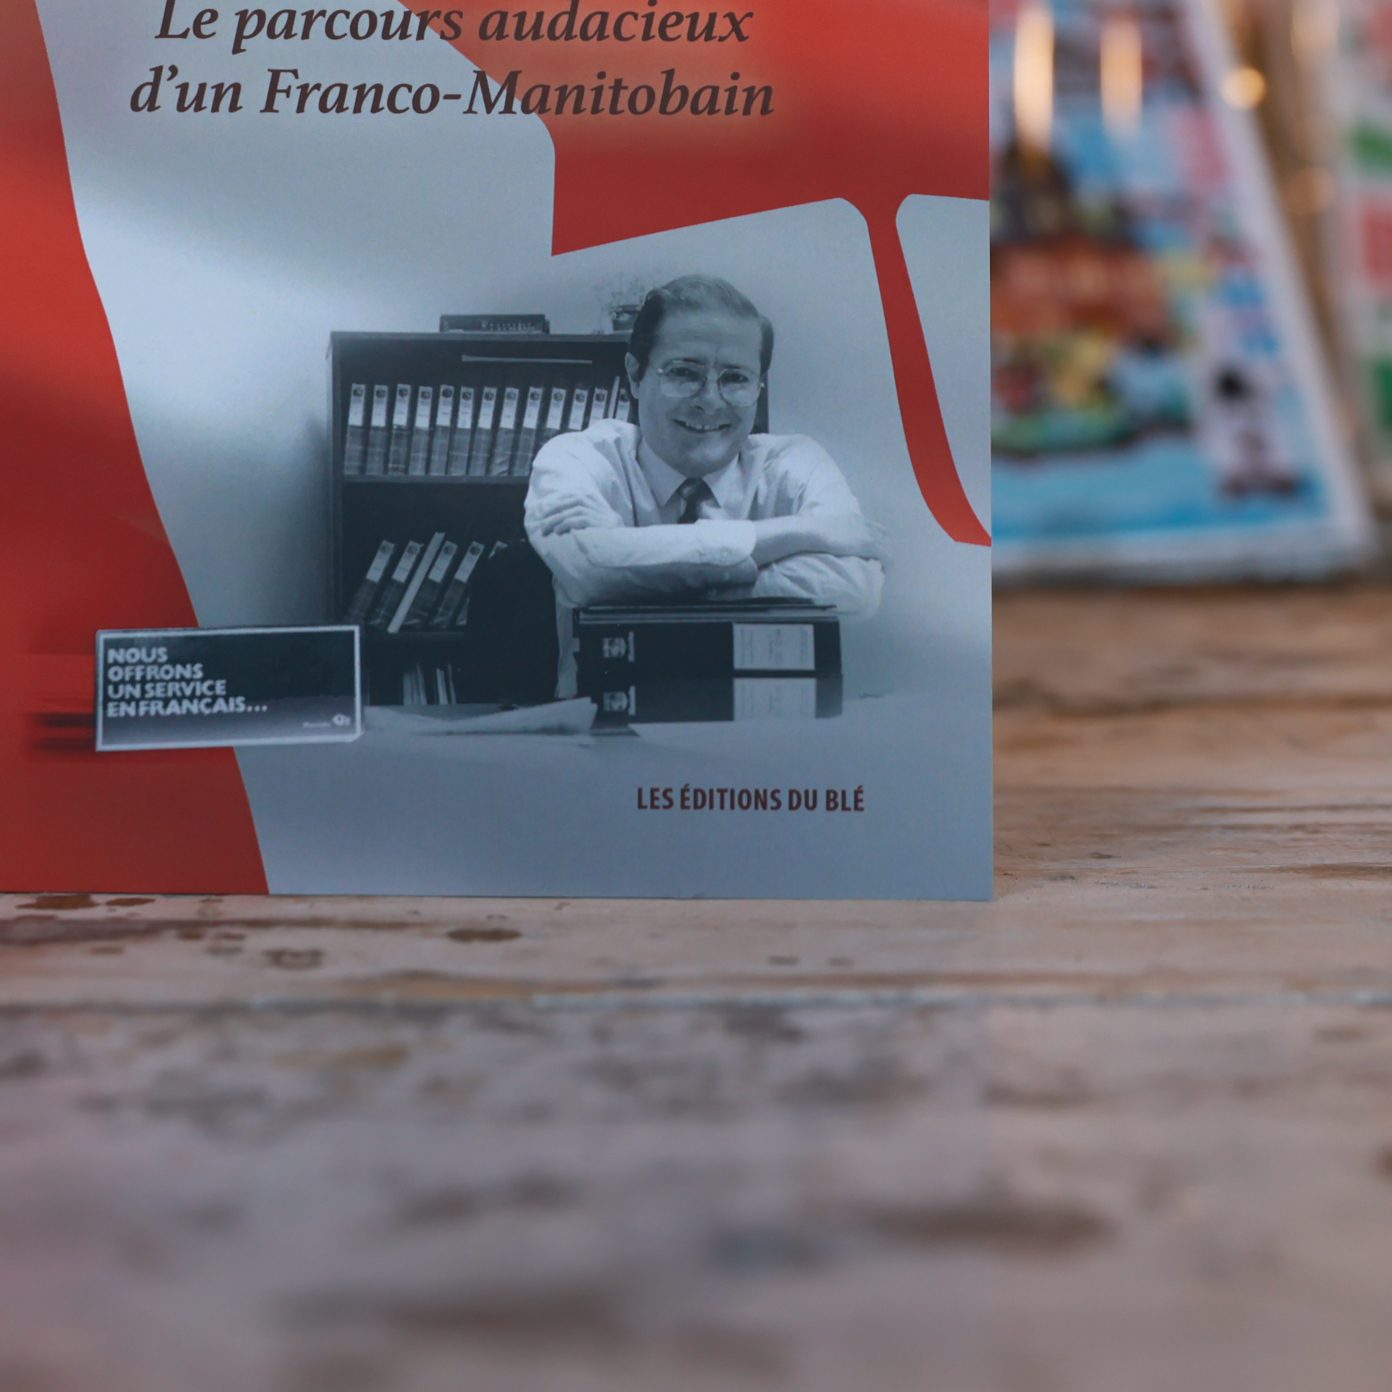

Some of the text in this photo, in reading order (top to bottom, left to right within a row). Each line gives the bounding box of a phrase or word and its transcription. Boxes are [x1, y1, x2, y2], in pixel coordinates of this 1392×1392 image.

[231, 5, 464, 55] parcours
[129, 64, 776, 118] d’un Franco-Manitobain
[108, 647, 168, 663] NOUS
[108, 664, 204, 681] OFFRONS
[108, 680, 227, 699] UN SERVICE
[107, 700, 137, 718] EN
[636, 783, 865, 812] LES ÉDITIONS DU BLÉ
